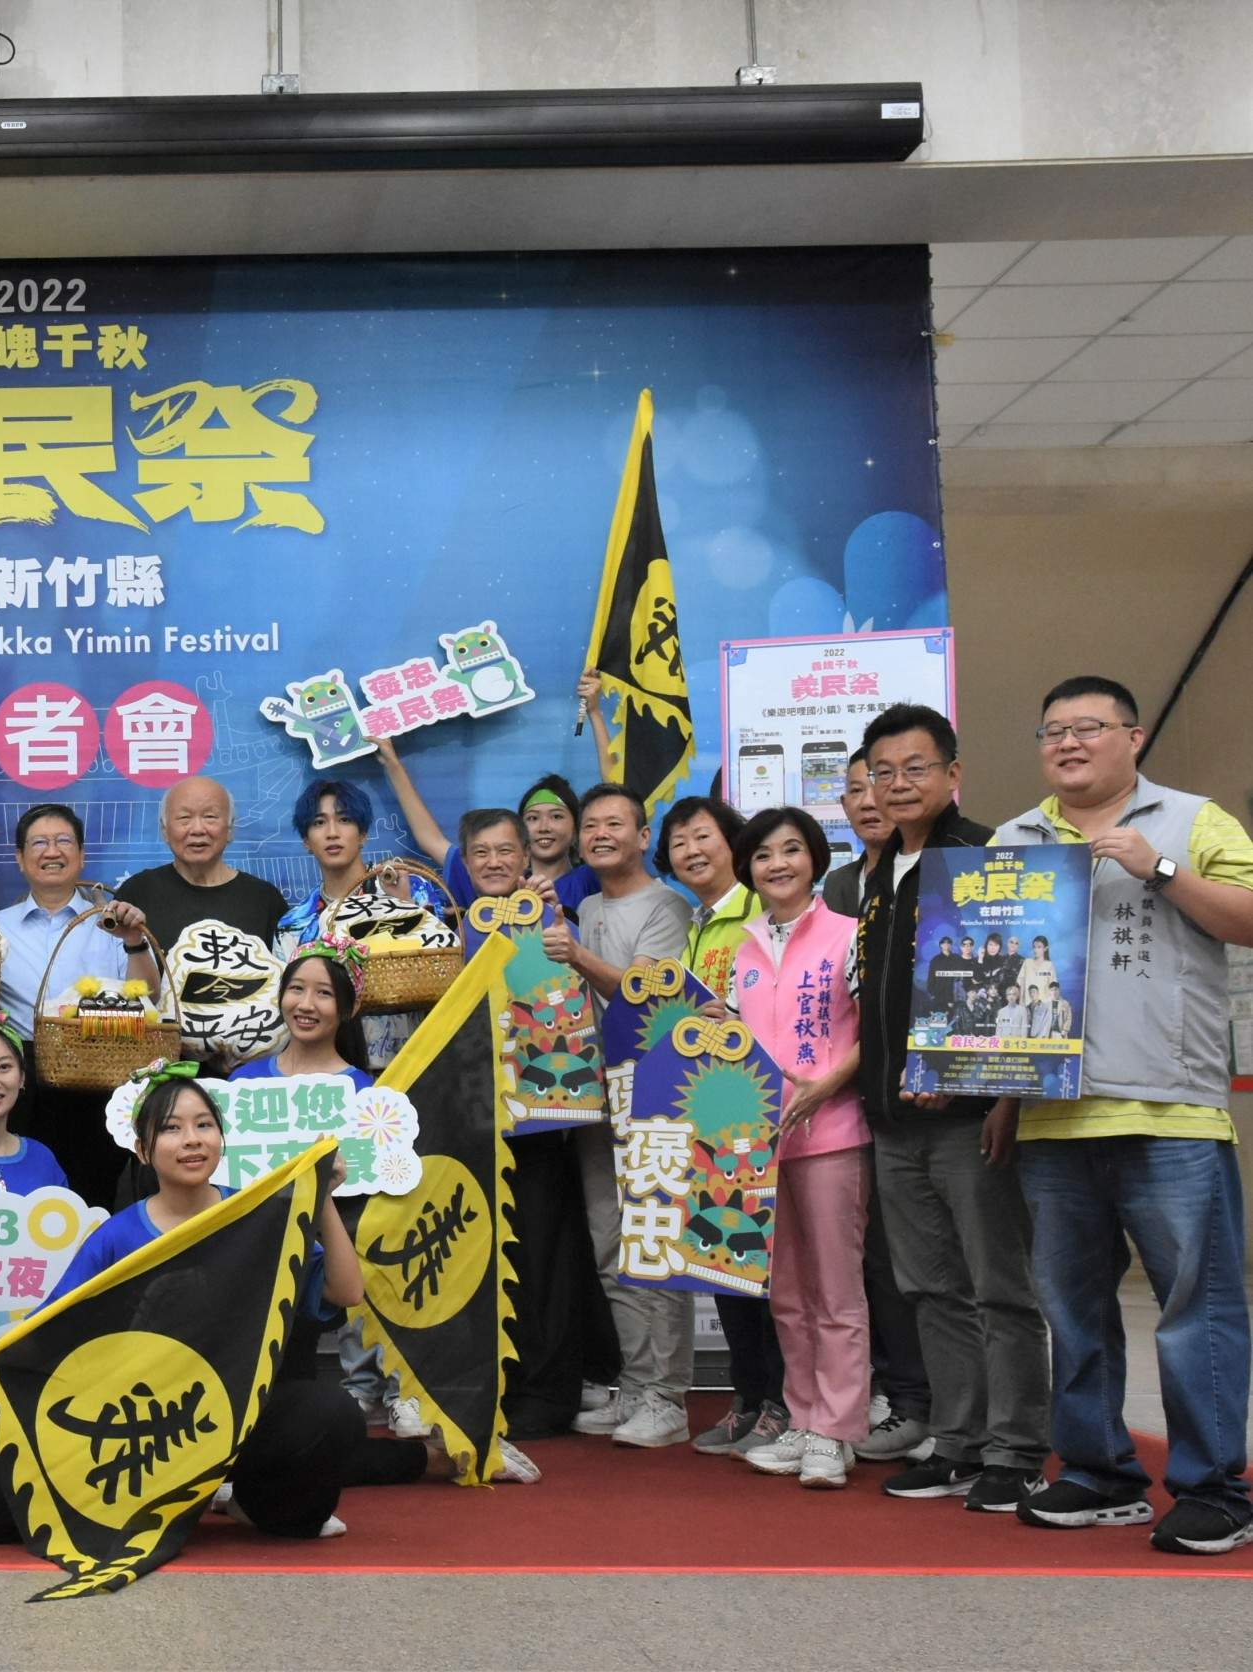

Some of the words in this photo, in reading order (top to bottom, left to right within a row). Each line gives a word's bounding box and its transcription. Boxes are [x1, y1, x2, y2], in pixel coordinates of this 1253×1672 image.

[64, 625, 152, 654] Yimin
[163, 622, 280, 653] Festival
[823, 649, 845, 657] 2022
[366, 661, 437, 701] 褒忠
[791, 672, 880, 702] 義民祭
[363, 684, 468, 738] 義民祭
[952, 871, 1056, 907] 義民祭
[1111, 902, 1136, 972] 林祺軒
[794, 970, 818, 1065] 上官秋燕
[817, 958, 834, 1038] 新竹縣議員
[181, 1004, 282, 1053] 平安
[623, 1119, 694, 1276] 褒忠
